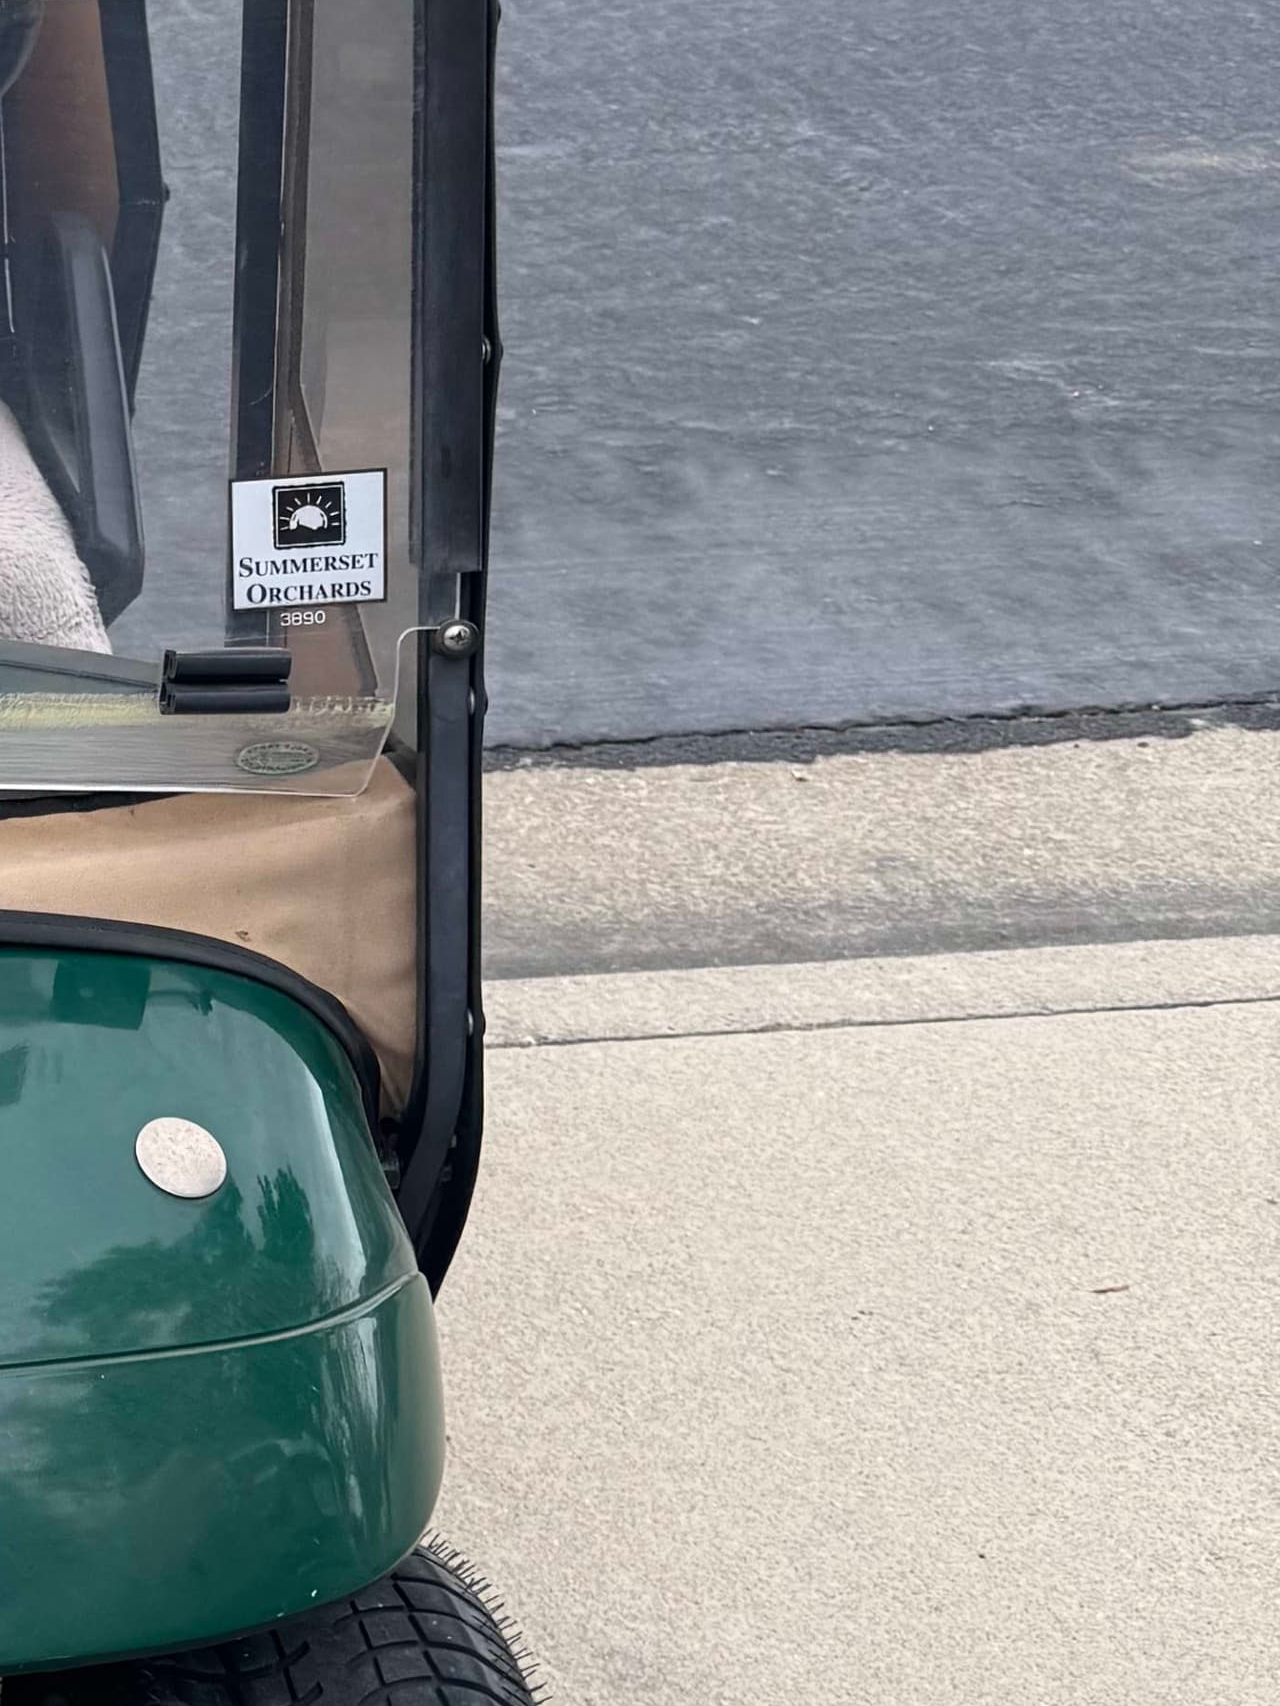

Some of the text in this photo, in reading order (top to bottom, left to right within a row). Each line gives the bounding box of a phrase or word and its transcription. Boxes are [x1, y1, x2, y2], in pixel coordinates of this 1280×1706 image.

[239, 552, 379, 579] SUMMERSET
[246, 580, 372, 605] ORCHARDS
[280, 610, 326, 627] 3890
